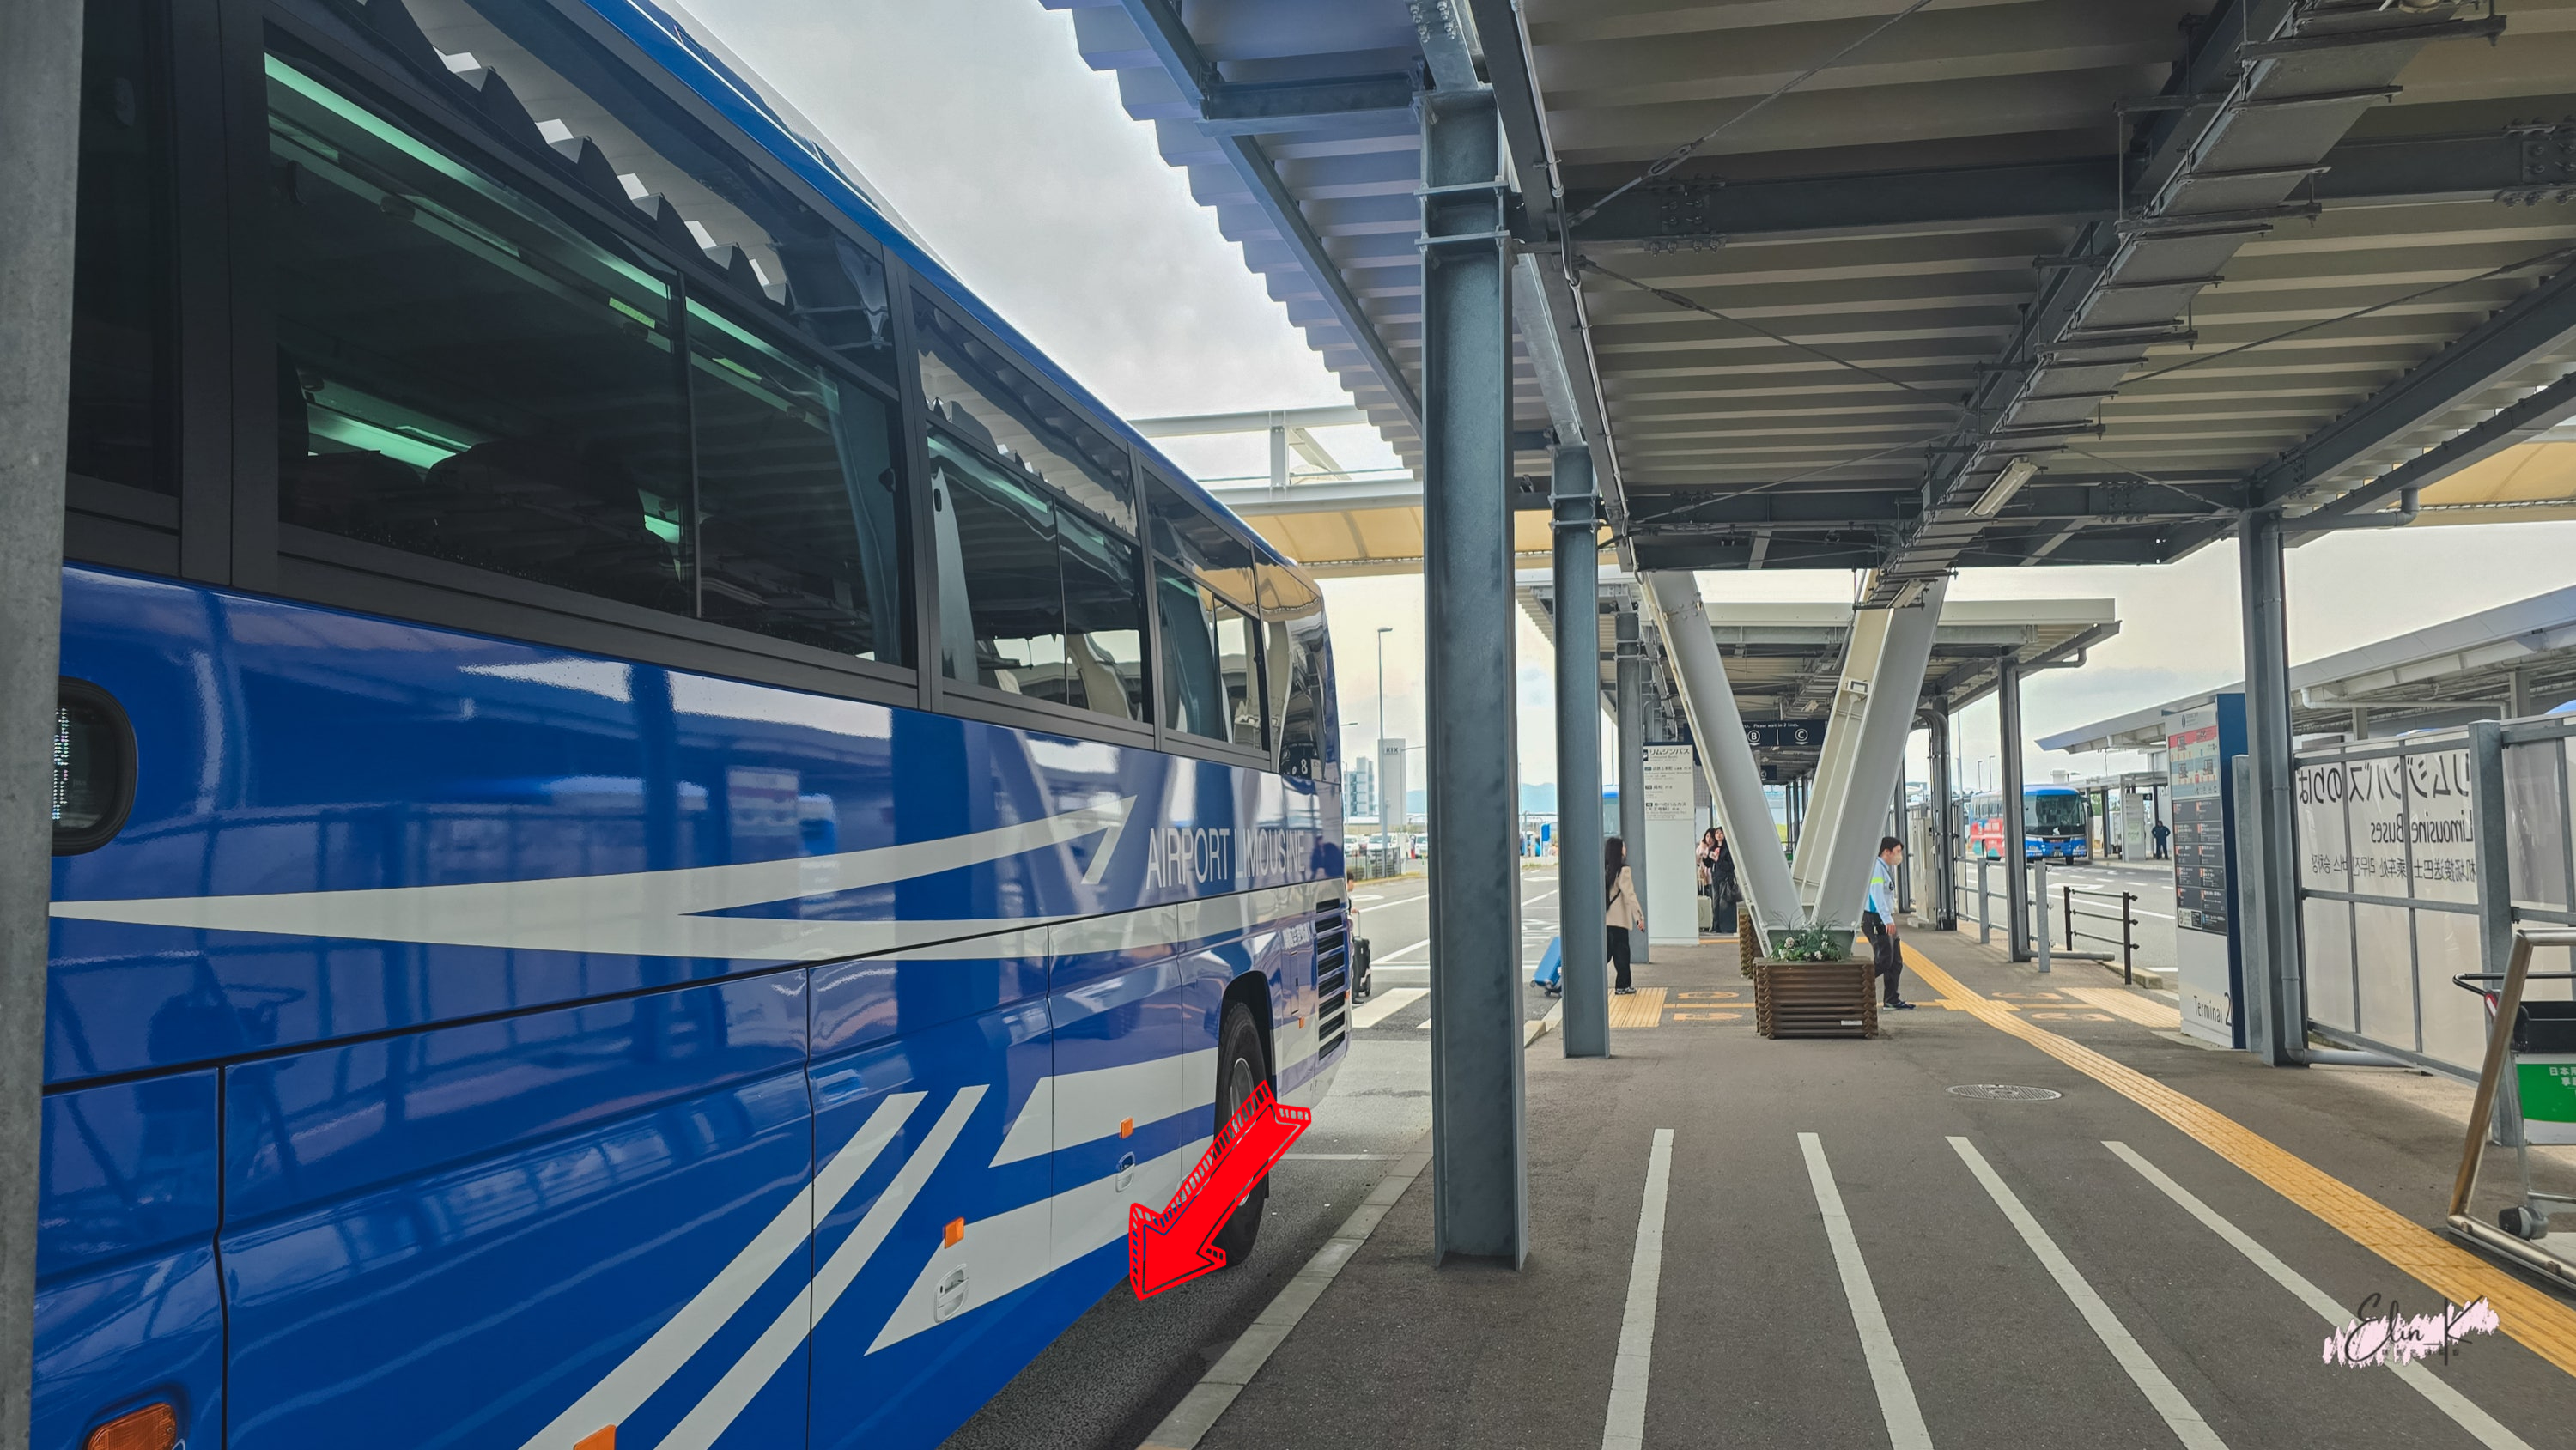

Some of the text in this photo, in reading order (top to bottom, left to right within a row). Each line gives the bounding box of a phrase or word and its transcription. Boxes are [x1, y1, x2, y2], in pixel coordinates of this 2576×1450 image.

[1146, 828, 1306, 890] AIRPORT LIMOUSINE
[2194, 992, 2233, 1027] Terminal 2
